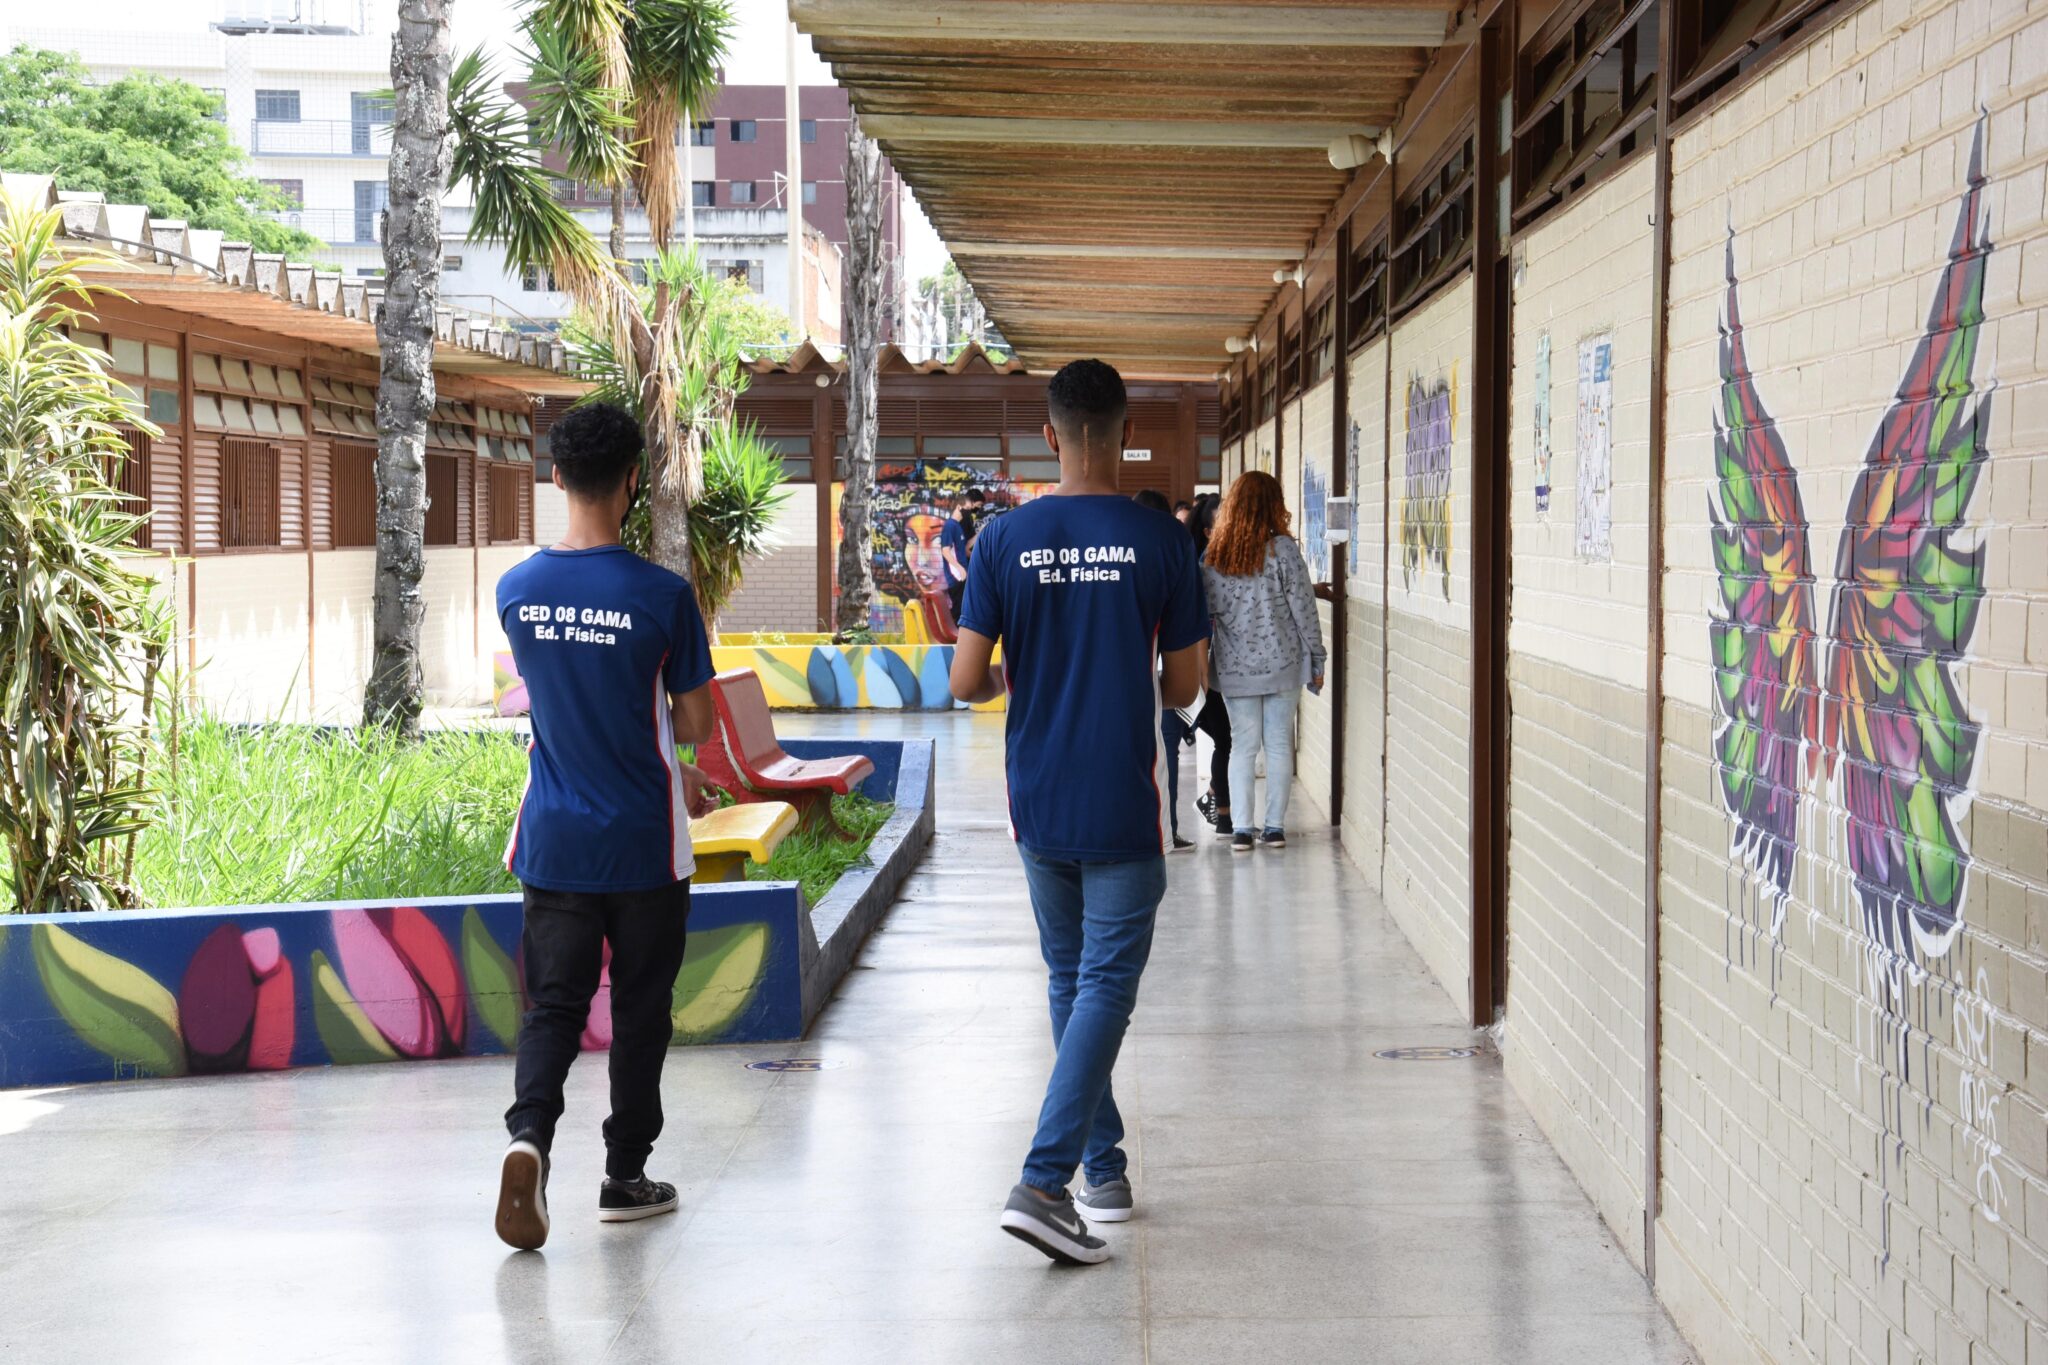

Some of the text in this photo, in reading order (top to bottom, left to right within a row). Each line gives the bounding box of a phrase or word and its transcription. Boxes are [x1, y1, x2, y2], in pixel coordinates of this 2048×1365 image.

[1020, 546, 1136, 568] CED 08 GAMA
[1039, 566, 1120, 583] Ed. Física
[519, 605, 632, 630] CED 08 GAMA
[534, 625, 616, 645] Ed. Física
